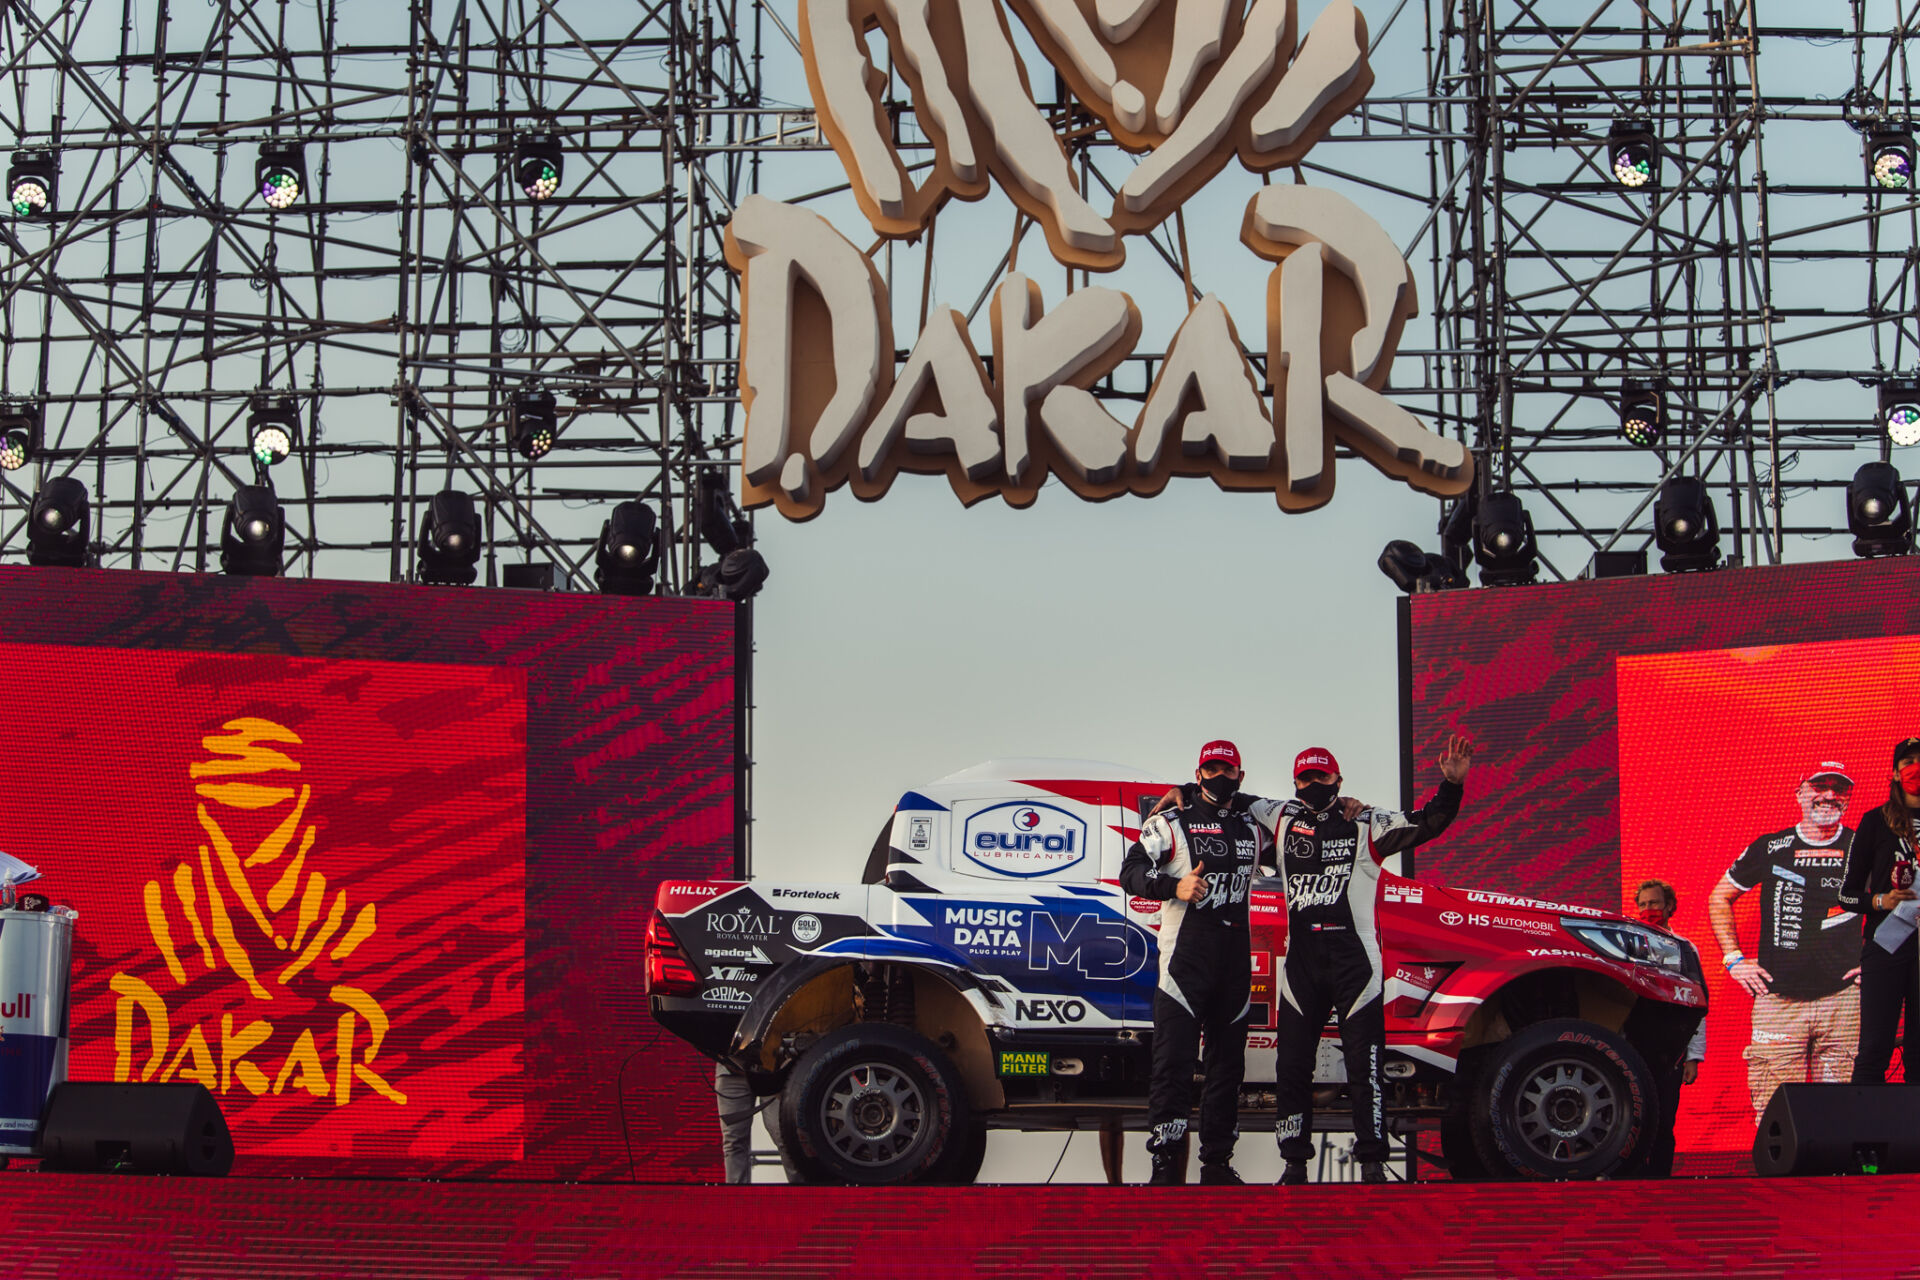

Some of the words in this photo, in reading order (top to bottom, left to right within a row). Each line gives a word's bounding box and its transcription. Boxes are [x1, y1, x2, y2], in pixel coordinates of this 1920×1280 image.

[728, 184, 1472, 515] DAKAR
[1202, 748, 1234, 758] RED
[1296, 755, 1329, 767] RED
[974, 828, 1077, 854] eurol
[1321, 838, 1356, 849] MUSIC
[973, 851, 1075, 861] LUBRICANTS
[1321, 848, 1351, 859] DATA
[1324, 862, 1353, 874] ONE
[1793, 857, 1844, 867] HILUX
[669, 885, 719, 896] HILUX
[782, 888, 841, 900] Fortelock
[1288, 873, 1351, 903] SHOT
[1384, 886, 1424, 897] RED
[706, 912, 781, 935] ROYAL
[945, 908, 1024, 927] MUSIC
[1468, 913, 1490, 927] HS
[1492, 916, 1558, 932] AUTOMOBIL
[797, 920, 817, 928] GOLD
[716, 933, 741, 941] ROYAL
[742, 934, 768, 942] WATER
[954, 928, 1022, 948] DATA
[969, 948, 991, 956] PLUG
[1028, 911, 1149, 981] MD
[704, 948, 753, 960] agados
[1526, 949, 1606, 963] YASHICA
[705, 966, 759, 982] XTline
[1395, 968, 1412, 982] DZ
[711, 986, 745, 1001] PRIM
[0, 993, 31, 1019] ull
[1015, 999, 1087, 1024] NEXO
[109, 972, 408, 1106] DAKAR
[1002, 1054, 1047, 1064] MANN
[1002, 1064, 1047, 1074] FILTER
